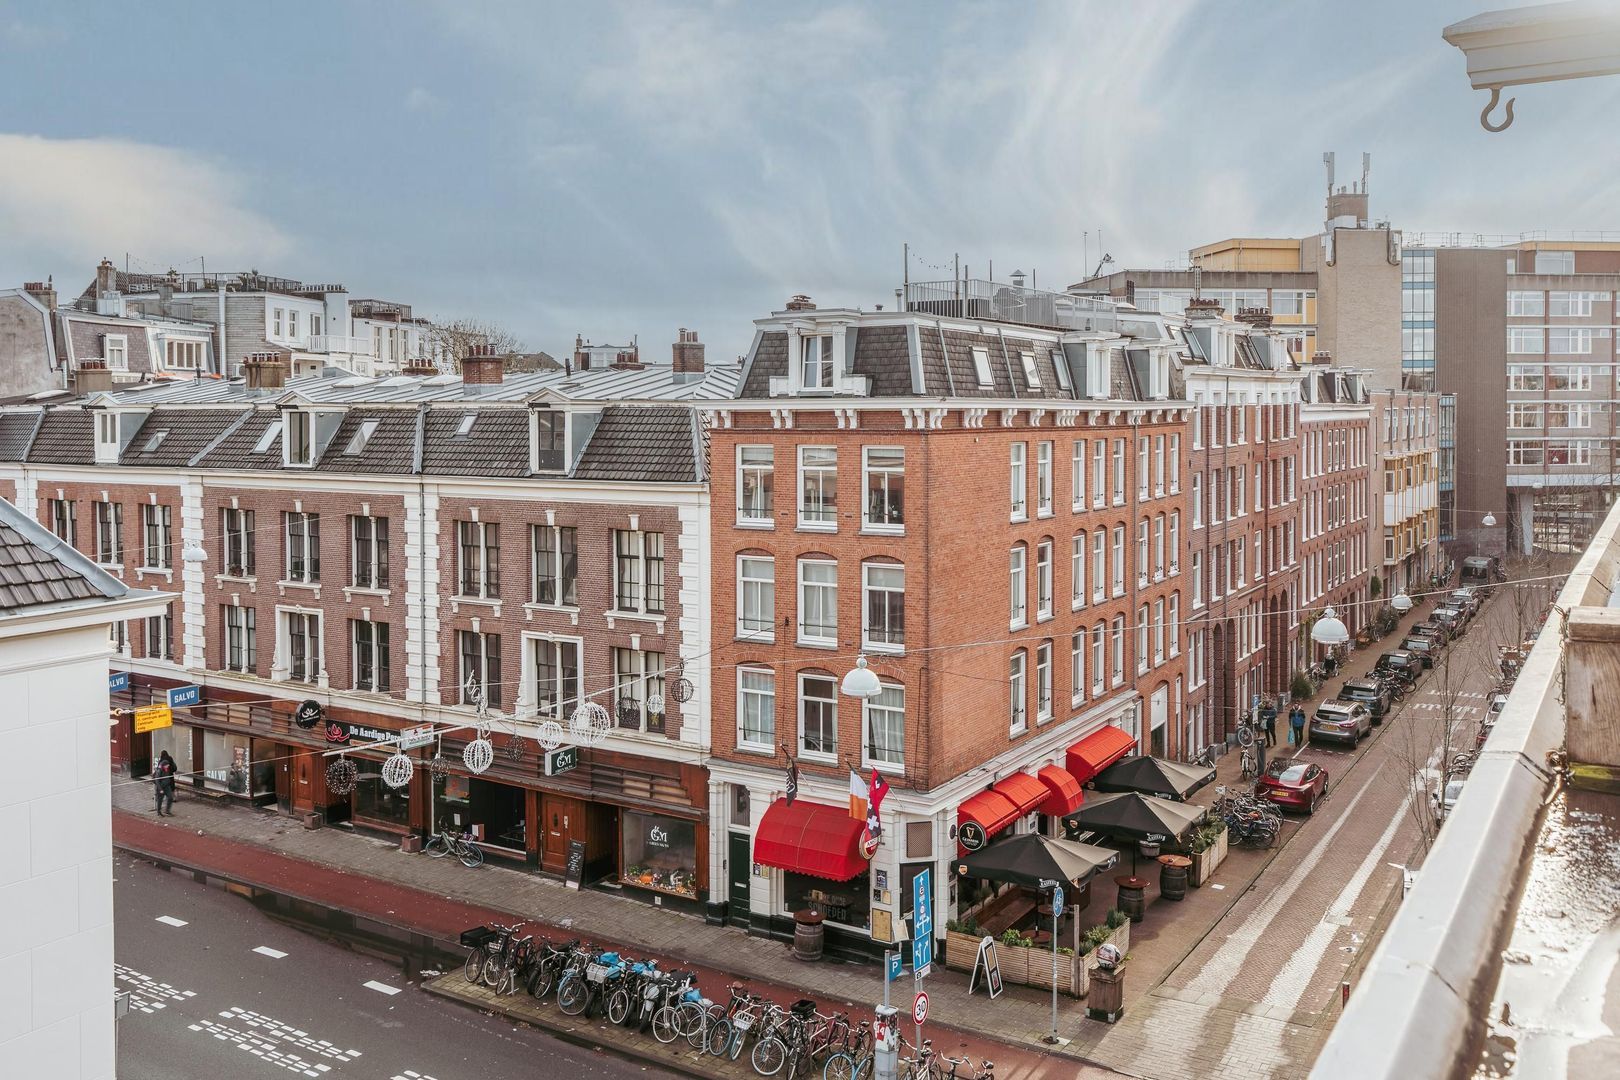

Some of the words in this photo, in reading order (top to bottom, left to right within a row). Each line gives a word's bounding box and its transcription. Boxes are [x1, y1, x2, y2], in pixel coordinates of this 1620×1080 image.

[109, 677, 124, 687] ALVO
[174, 691, 195, 703] SALVO
[349, 725, 358, 735] De
[359, 728, 386, 741] Aardige
[206, 770, 227, 781] SALVO
[892, 961, 899, 973] P
[916, 1000, 926, 1017] 30
